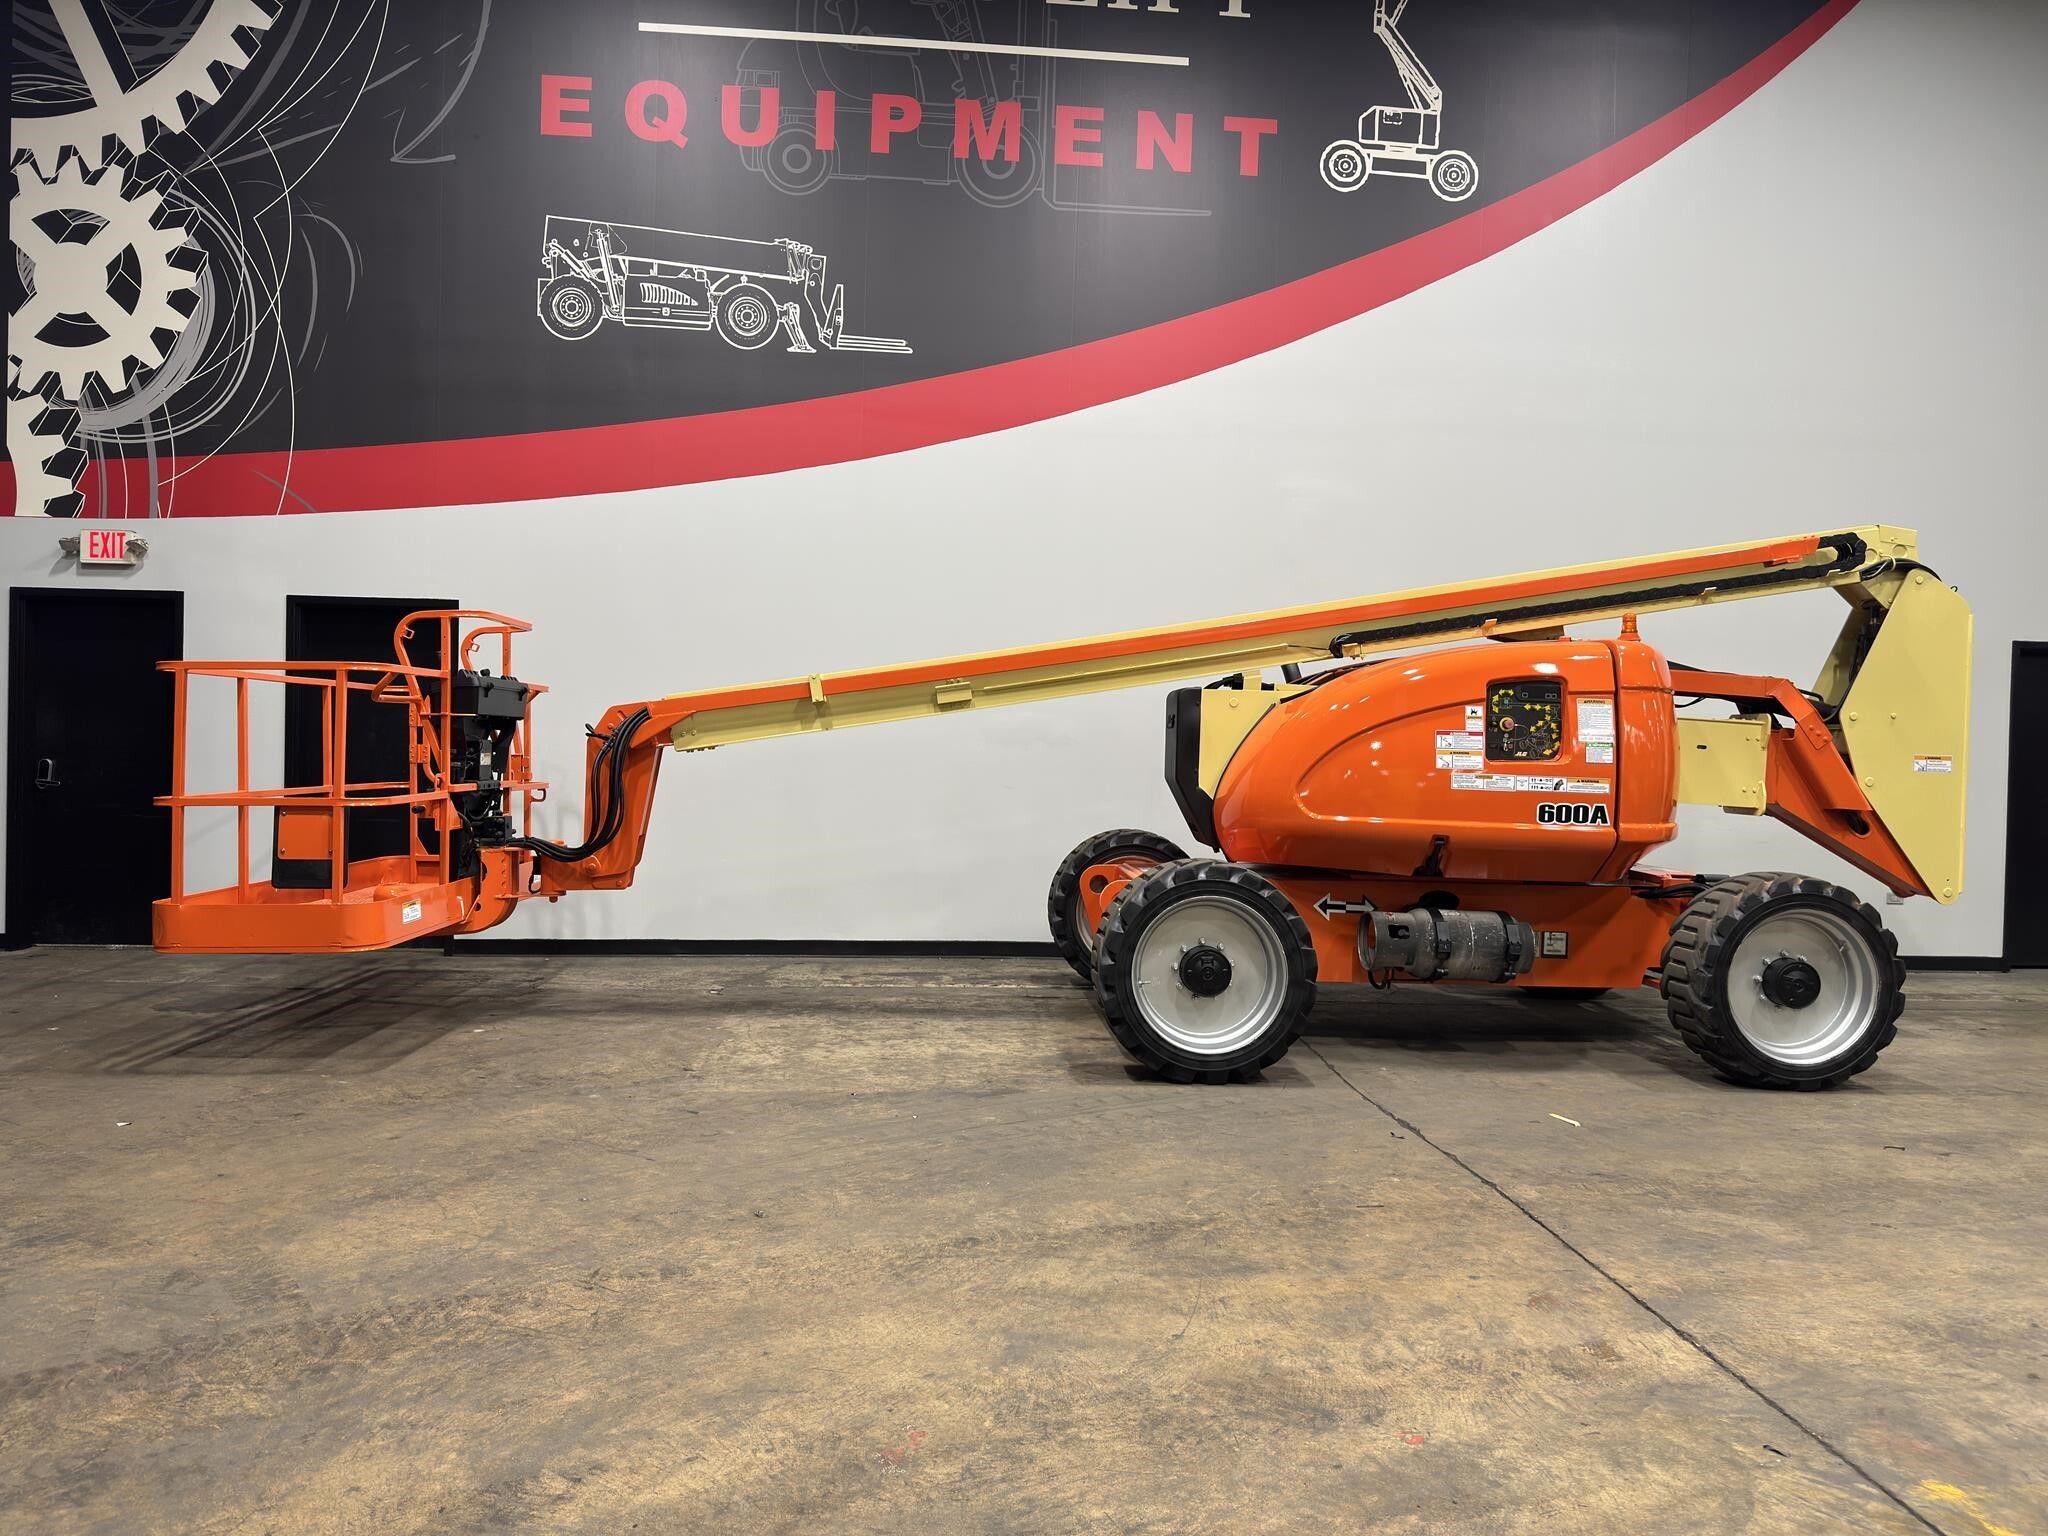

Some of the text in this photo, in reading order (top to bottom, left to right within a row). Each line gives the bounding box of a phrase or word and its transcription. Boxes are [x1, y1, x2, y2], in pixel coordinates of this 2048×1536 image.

[541, 75, 1278, 177] EQUIPMENT
[89, 531, 126, 558] EXIT
[1537, 803, 1610, 825] 600A
